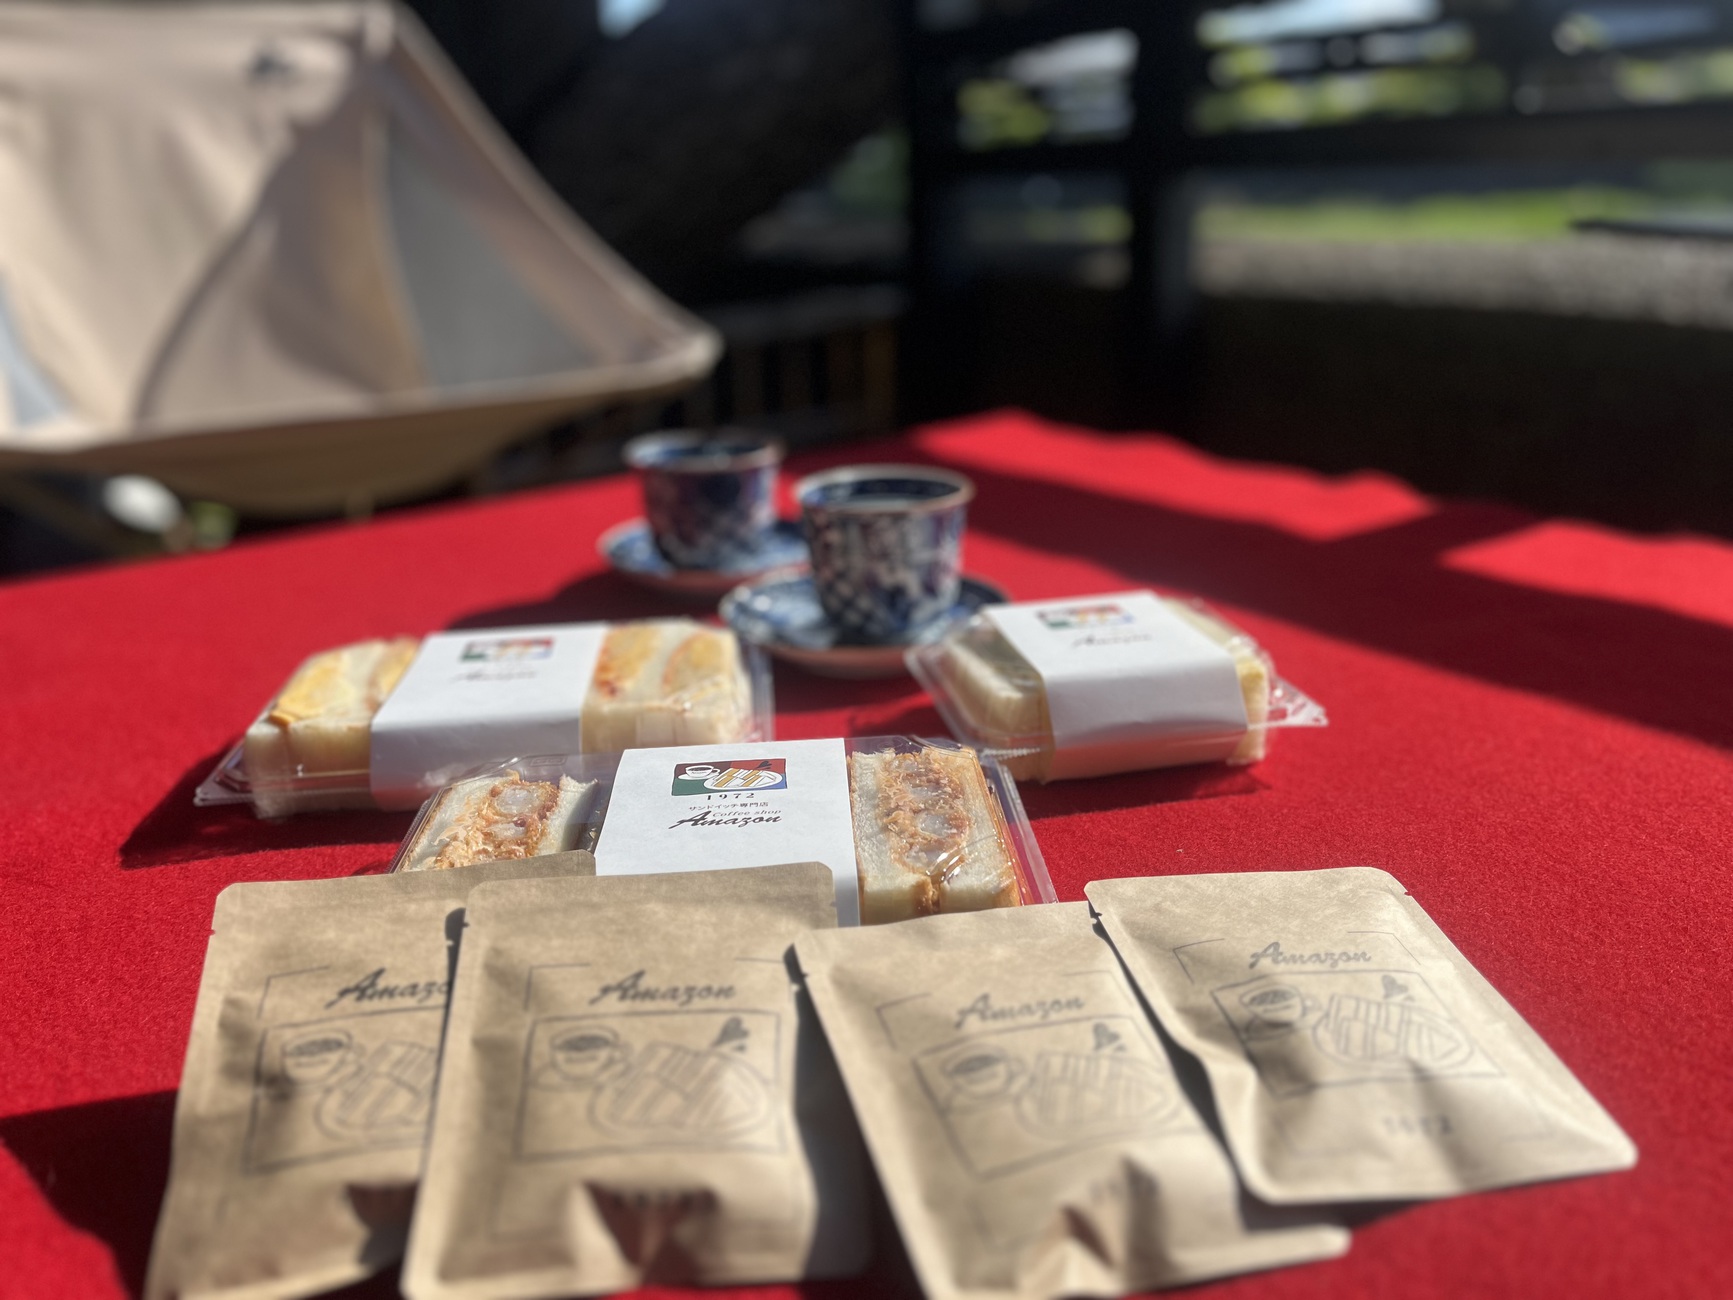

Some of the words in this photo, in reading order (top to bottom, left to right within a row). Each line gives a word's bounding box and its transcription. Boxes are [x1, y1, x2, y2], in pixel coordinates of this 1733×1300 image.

[689, 801, 769, 811] サンドイッチ専門店
[706, 793, 755, 801] 1972
[668, 810, 782, 829] Amazon
[1248, 941, 1372, 969] Amazon
[323, 967, 448, 1010] Amazo
[588, 969, 736, 1007] Amazon
[954, 992, 1085, 1030] Amazon
